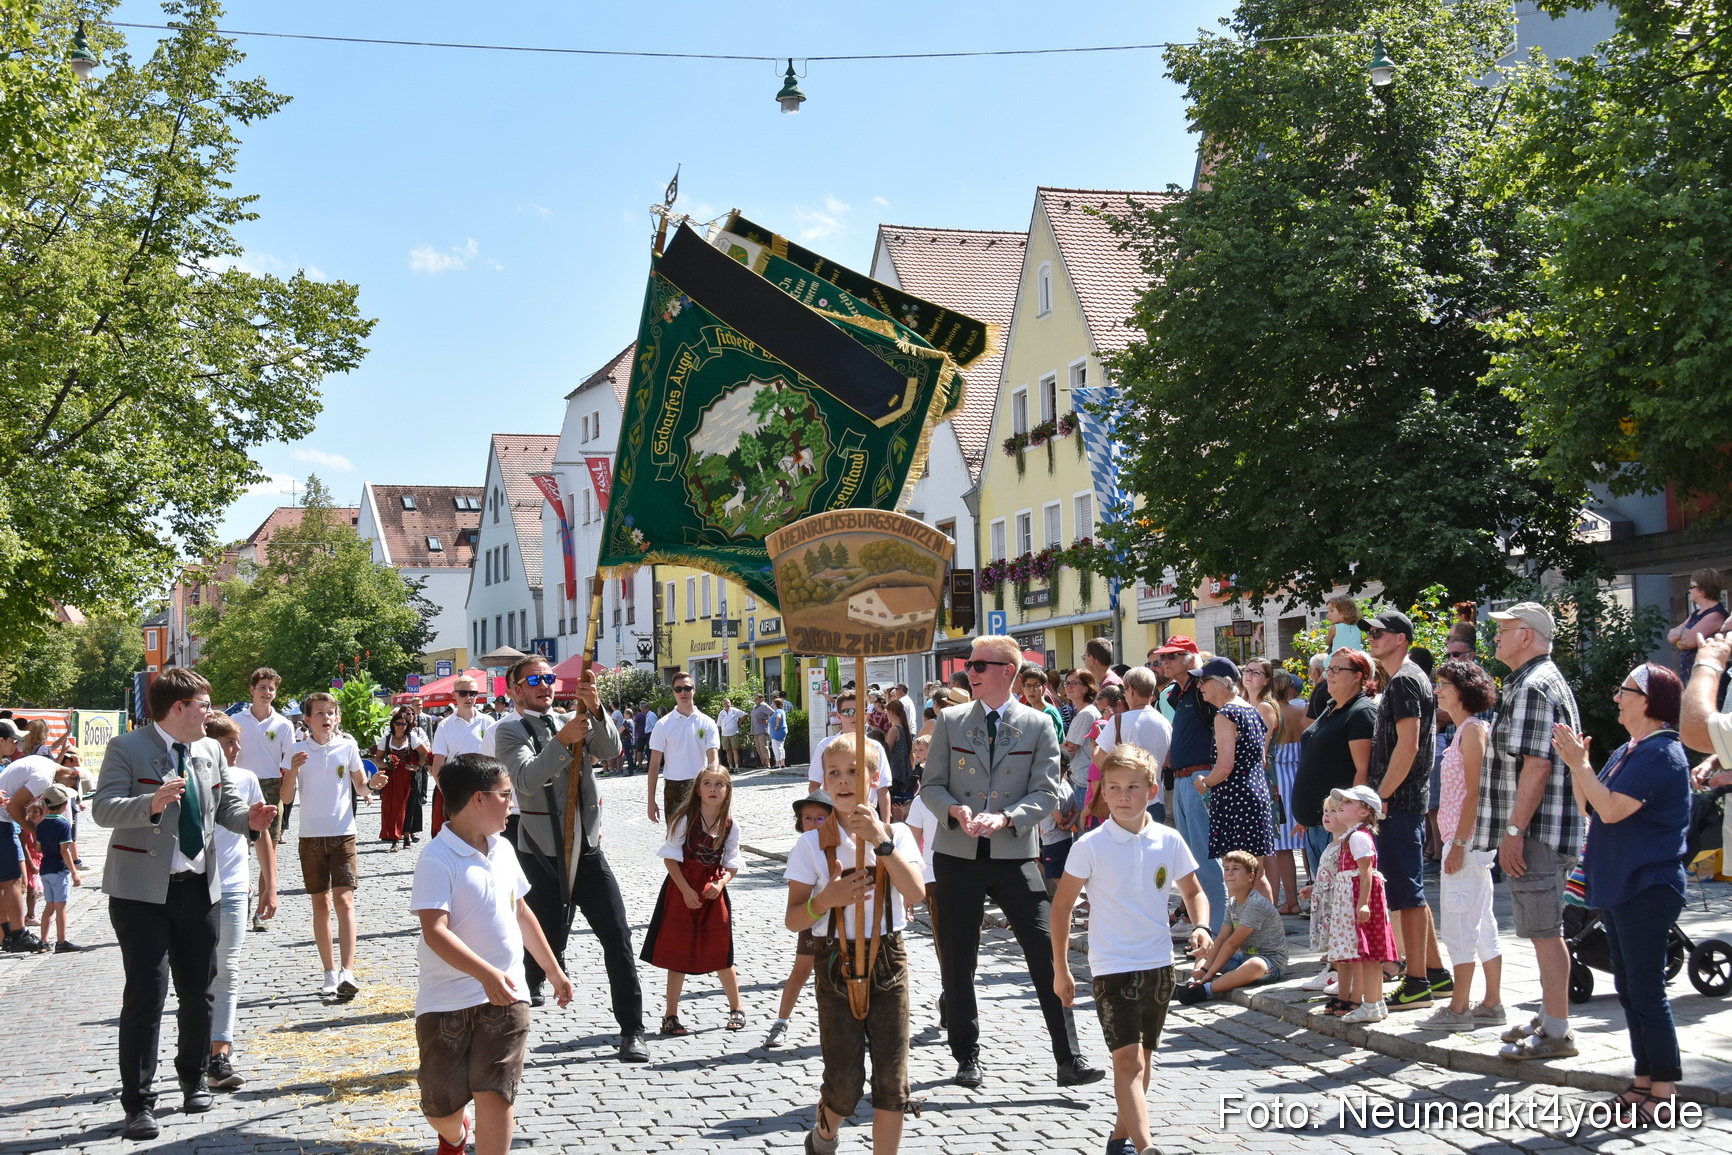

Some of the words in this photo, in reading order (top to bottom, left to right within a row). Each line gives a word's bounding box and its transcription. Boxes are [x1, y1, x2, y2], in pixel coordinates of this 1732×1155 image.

[803, 280, 820, 305] nserem
[839, 292, 861, 317] erein
[654, 389, 683, 455] Scharfes
[669, 351, 693, 389] Auge
[690, 639, 717, 653] Restaurant
